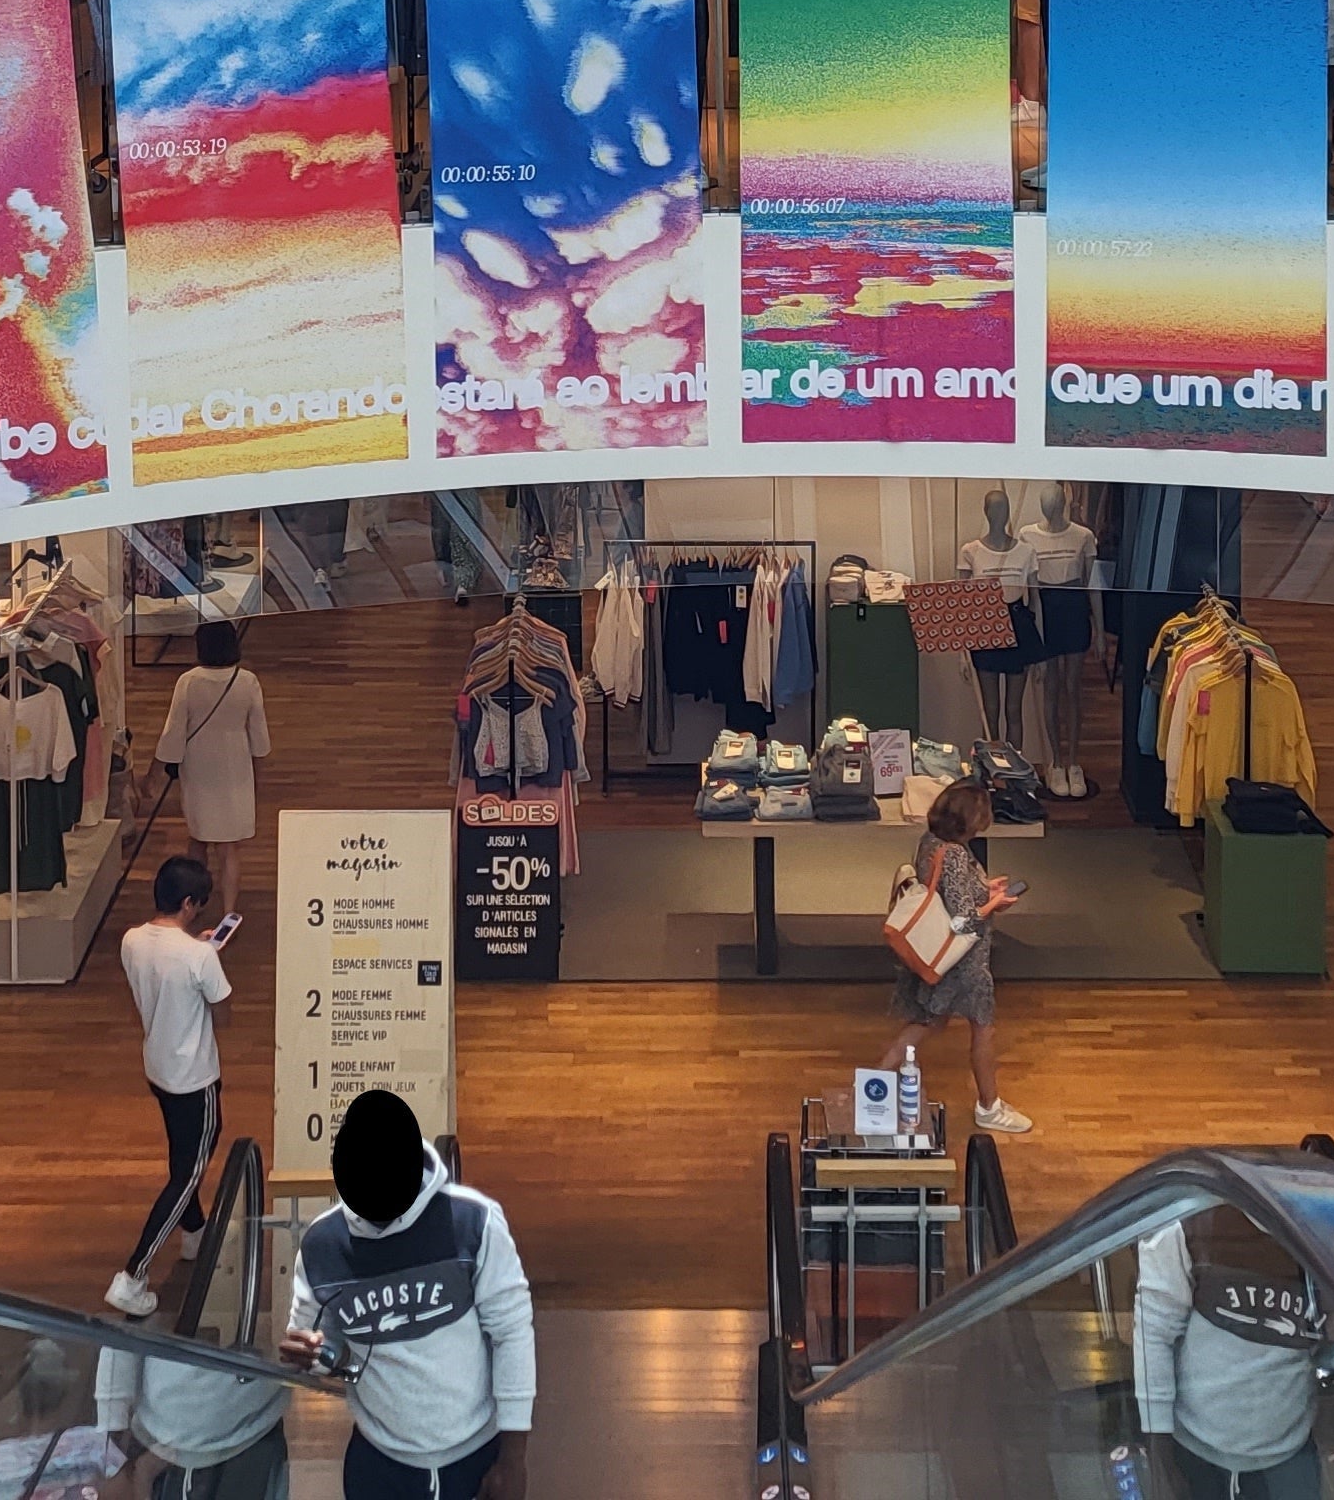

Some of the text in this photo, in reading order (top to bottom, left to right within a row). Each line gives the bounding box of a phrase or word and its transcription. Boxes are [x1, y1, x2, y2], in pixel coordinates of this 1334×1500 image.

[129, 137, 227, 161] 00:00:53:19
[440, 164, 536, 184] 00:00:55:10
[750, 197, 846, 215] 00:00:56:07
[789, 359, 846, 399] de
[856, 366, 924, 399] um
[1051, 362, 1143, 405] Que
[1152, 373, 1223, 408] um
[1233, 368, 1303, 411] dia
[435, 368, 545, 414] stará
[556, 373, 610, 408] ao
[200, 374, 408, 431] Chorando
[340, 833, 389, 851] votre
[326, 853, 403, 882] magasin
[476, 856, 551, 891] -50%
[333, 898, 396, 910] MODE HOMME
[466, 892, 551, 906] SUR UNE SÉLECTION
[307, 898, 325, 927] 3
[332, 918, 430, 930] CHAUSSURES HOMME
[474, 925, 537, 938] SIGNALÉS EN
[487, 942, 528, 955] MAGASIN
[332, 958, 413, 970] ESPACE SERVICES
[306, 989, 322, 1018] 2
[331, 989, 393, 1001] MODE FEMME
[331, 1010, 427, 1021] CHAUSSURES FEMME
[331, 1030, 388, 1041] SERVICE VIP
[307, 1060, 319, 1089] 1
[331, 1061, 396, 1072] MODE ENFANT
[330, 1081, 366, 1093] JOUETS
[394, 1081, 417, 1093] JEUX
[306, 1113, 323, 1142] 0
[338, 1281, 444, 1326] LACOSTE
